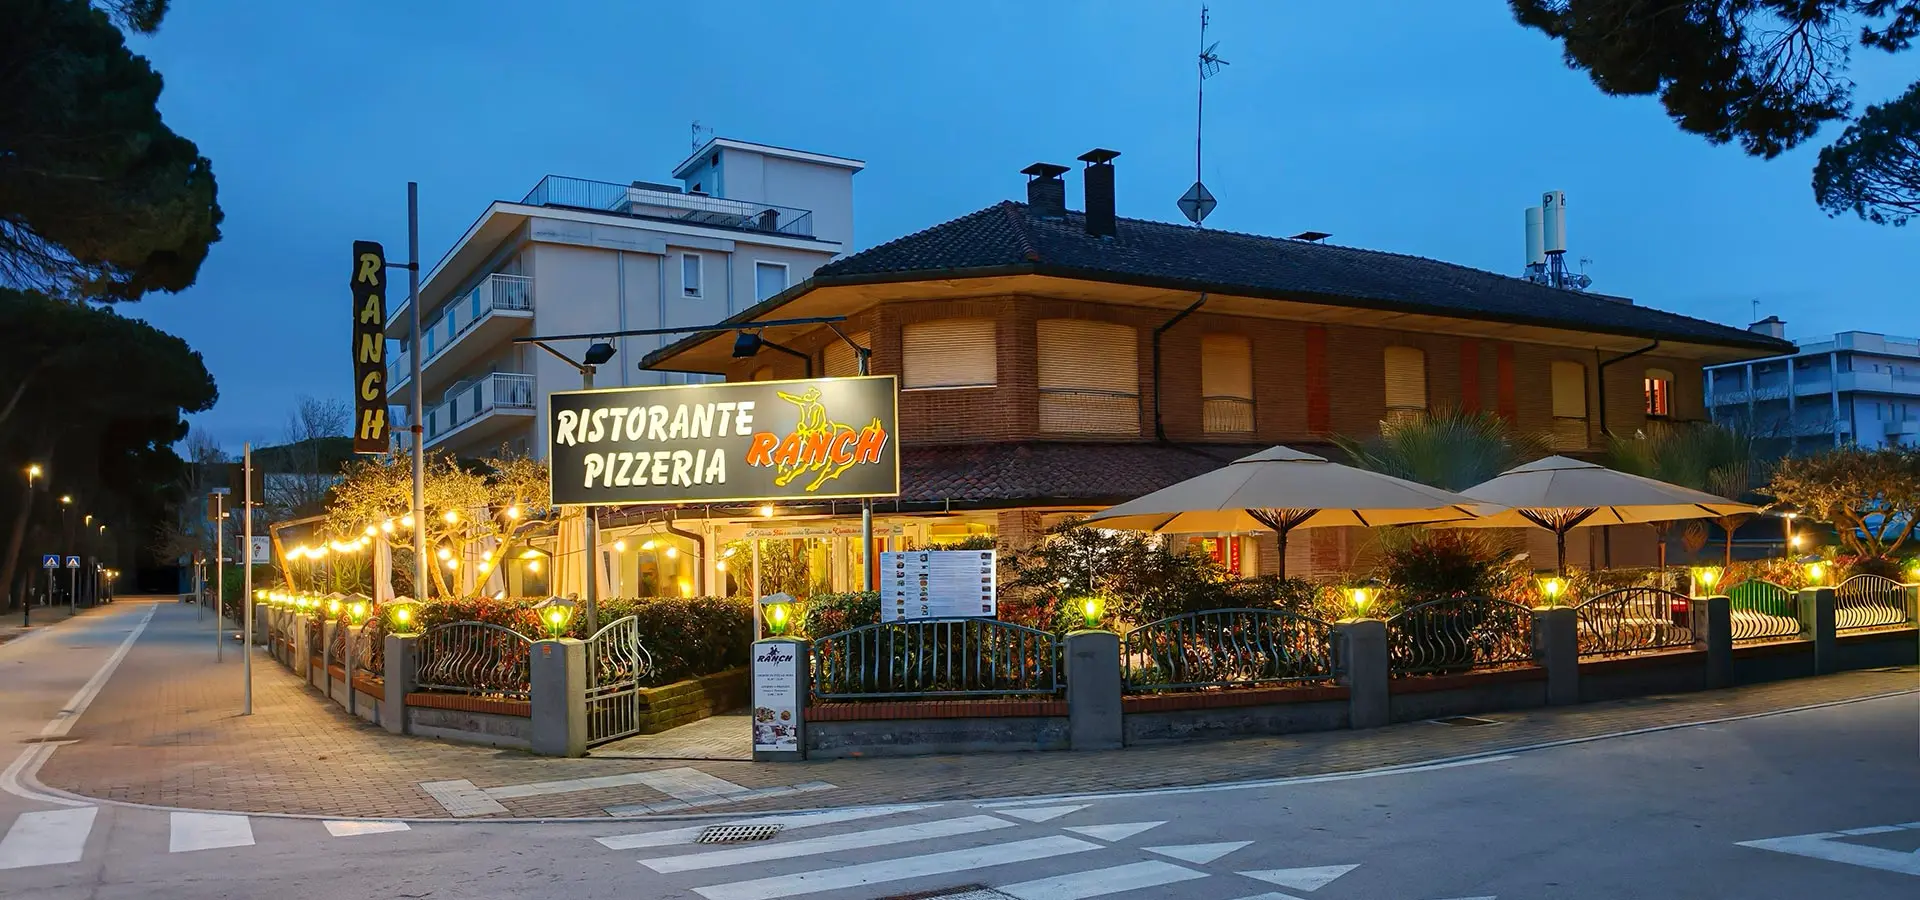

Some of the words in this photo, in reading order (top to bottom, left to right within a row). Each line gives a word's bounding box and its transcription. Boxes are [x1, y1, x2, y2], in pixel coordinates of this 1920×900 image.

[358, 253, 384, 439] RANCH
[557, 402, 755, 446] RISTORANTE
[747, 430, 888, 466] RANCH
[584, 449, 726, 488] PIZZERIA
[757, 655, 793, 663] RANCH
